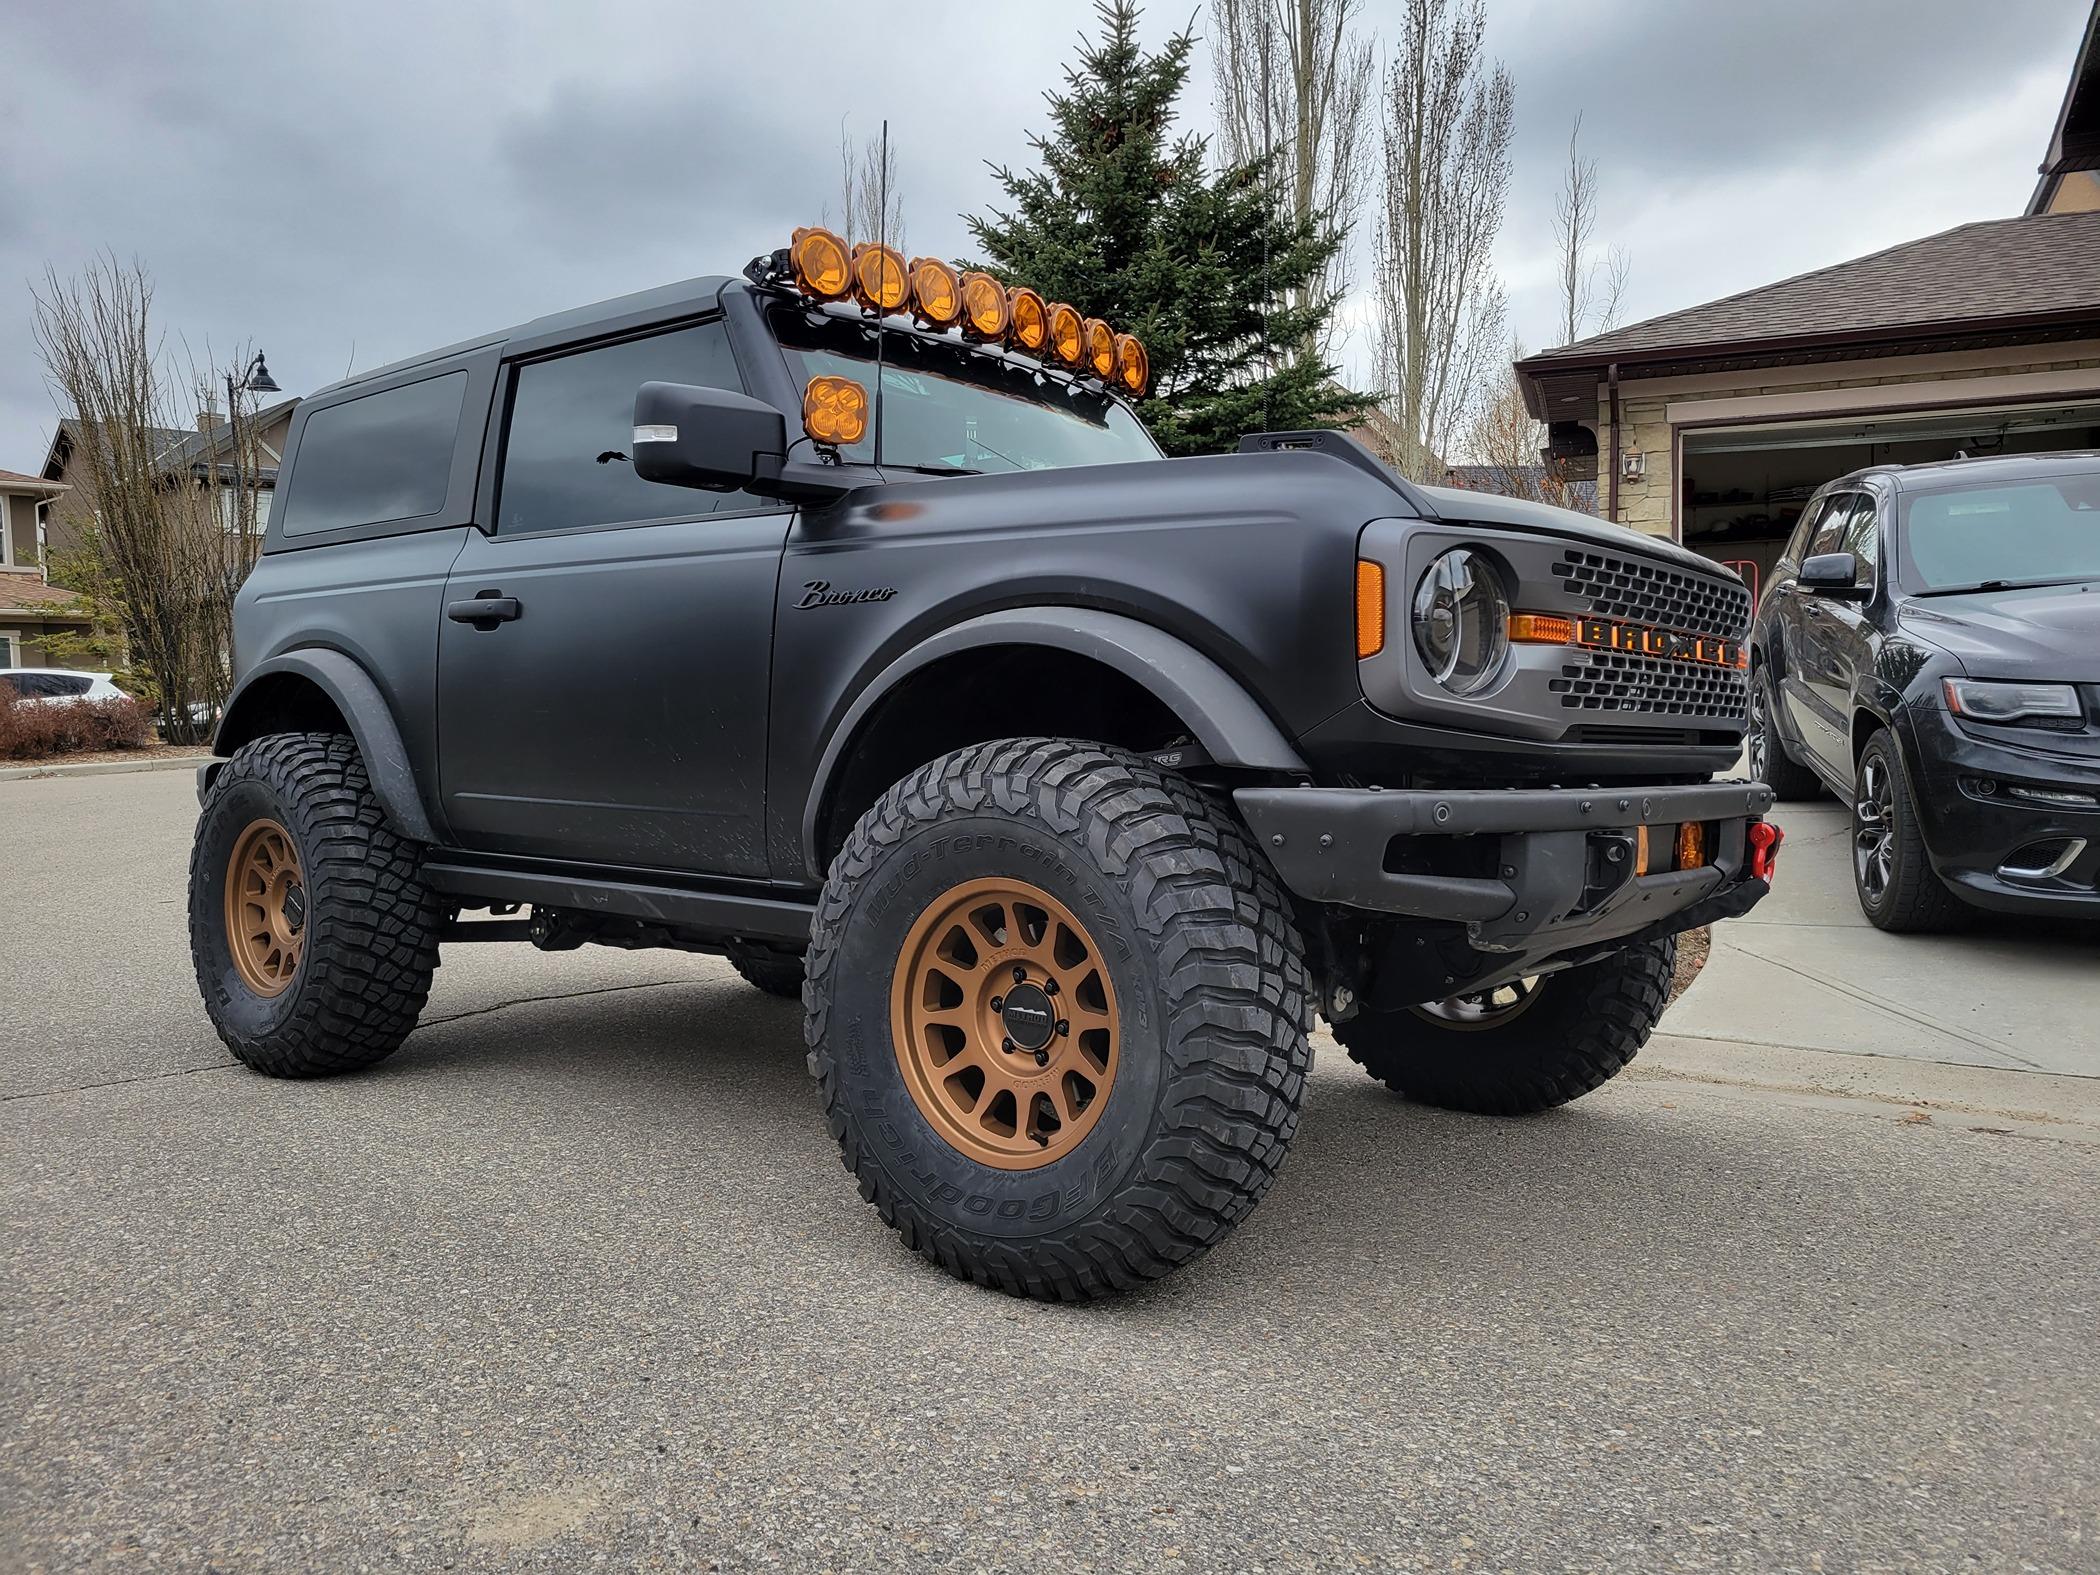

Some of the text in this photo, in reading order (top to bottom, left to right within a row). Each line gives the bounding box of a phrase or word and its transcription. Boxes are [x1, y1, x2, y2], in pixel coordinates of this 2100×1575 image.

[792, 579, 898, 609] Bronco
[1578, 621, 1739, 665] BRONCO
[864, 833, 1133, 963] Mud-Terrain T/A
[980, 947, 1028, 972] METHOD
[1008, 1010, 1048, 1024] METHOD
[863, 1089, 1119, 1223] BFGoodrich
